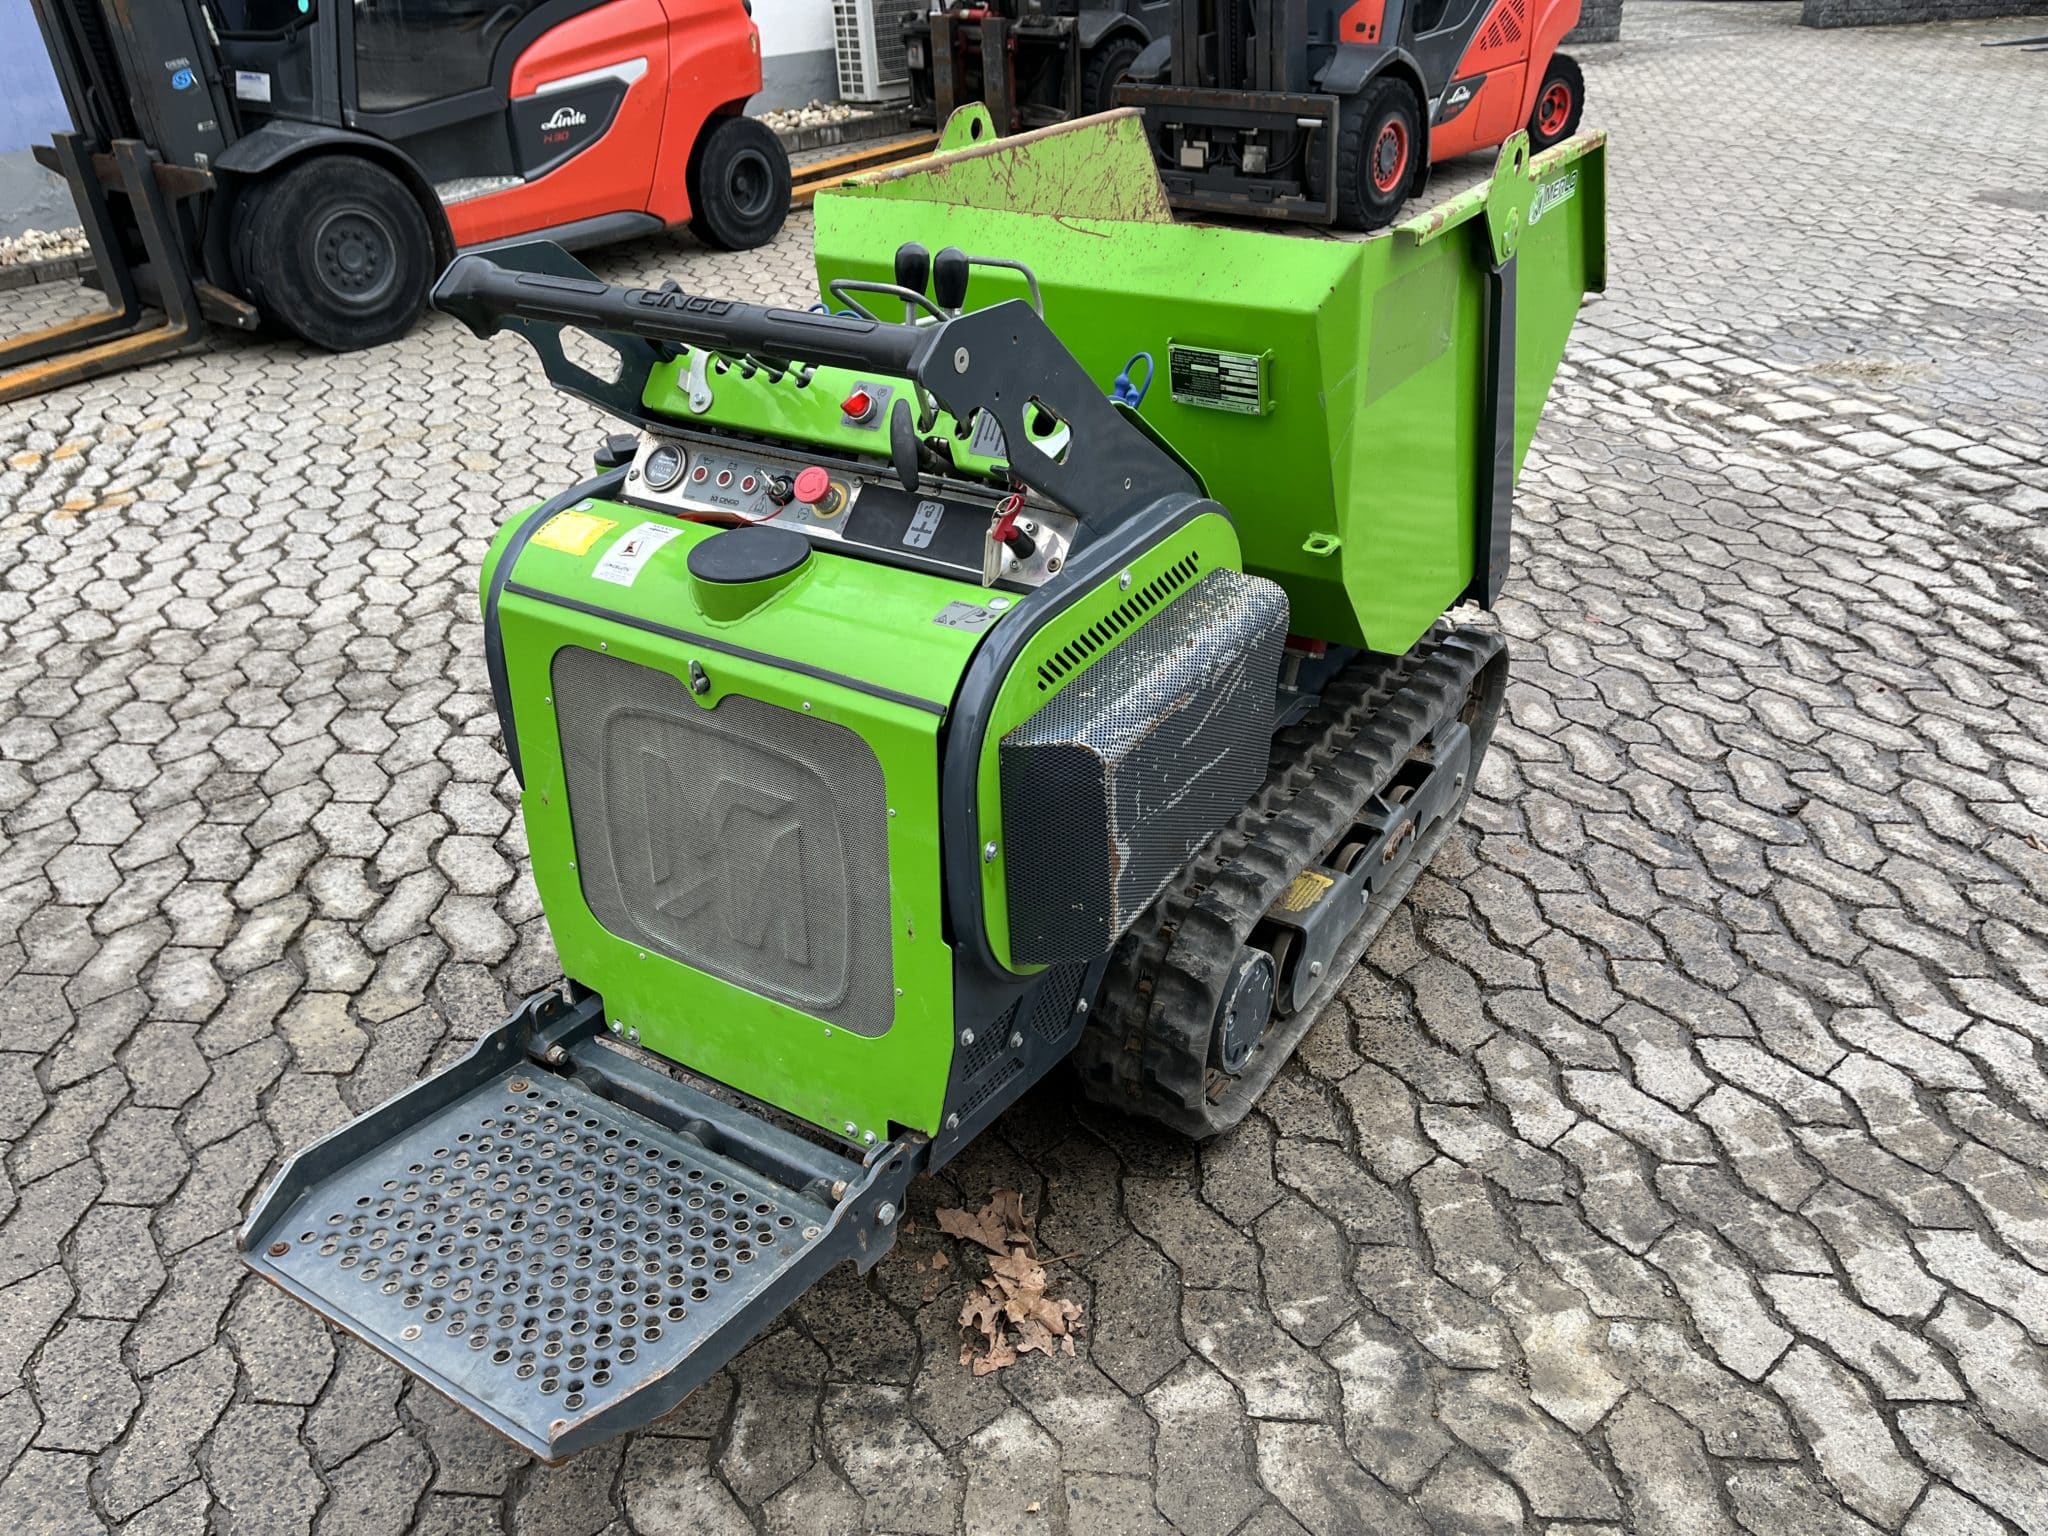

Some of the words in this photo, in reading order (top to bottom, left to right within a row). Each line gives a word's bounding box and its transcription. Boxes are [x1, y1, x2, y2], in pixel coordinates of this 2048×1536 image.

[541, 106, 586, 130] Linde
[1543, 169, 1578, 205] MERLO
[639, 291, 734, 316] CINGO
[719, 496, 740, 507] CINGO
